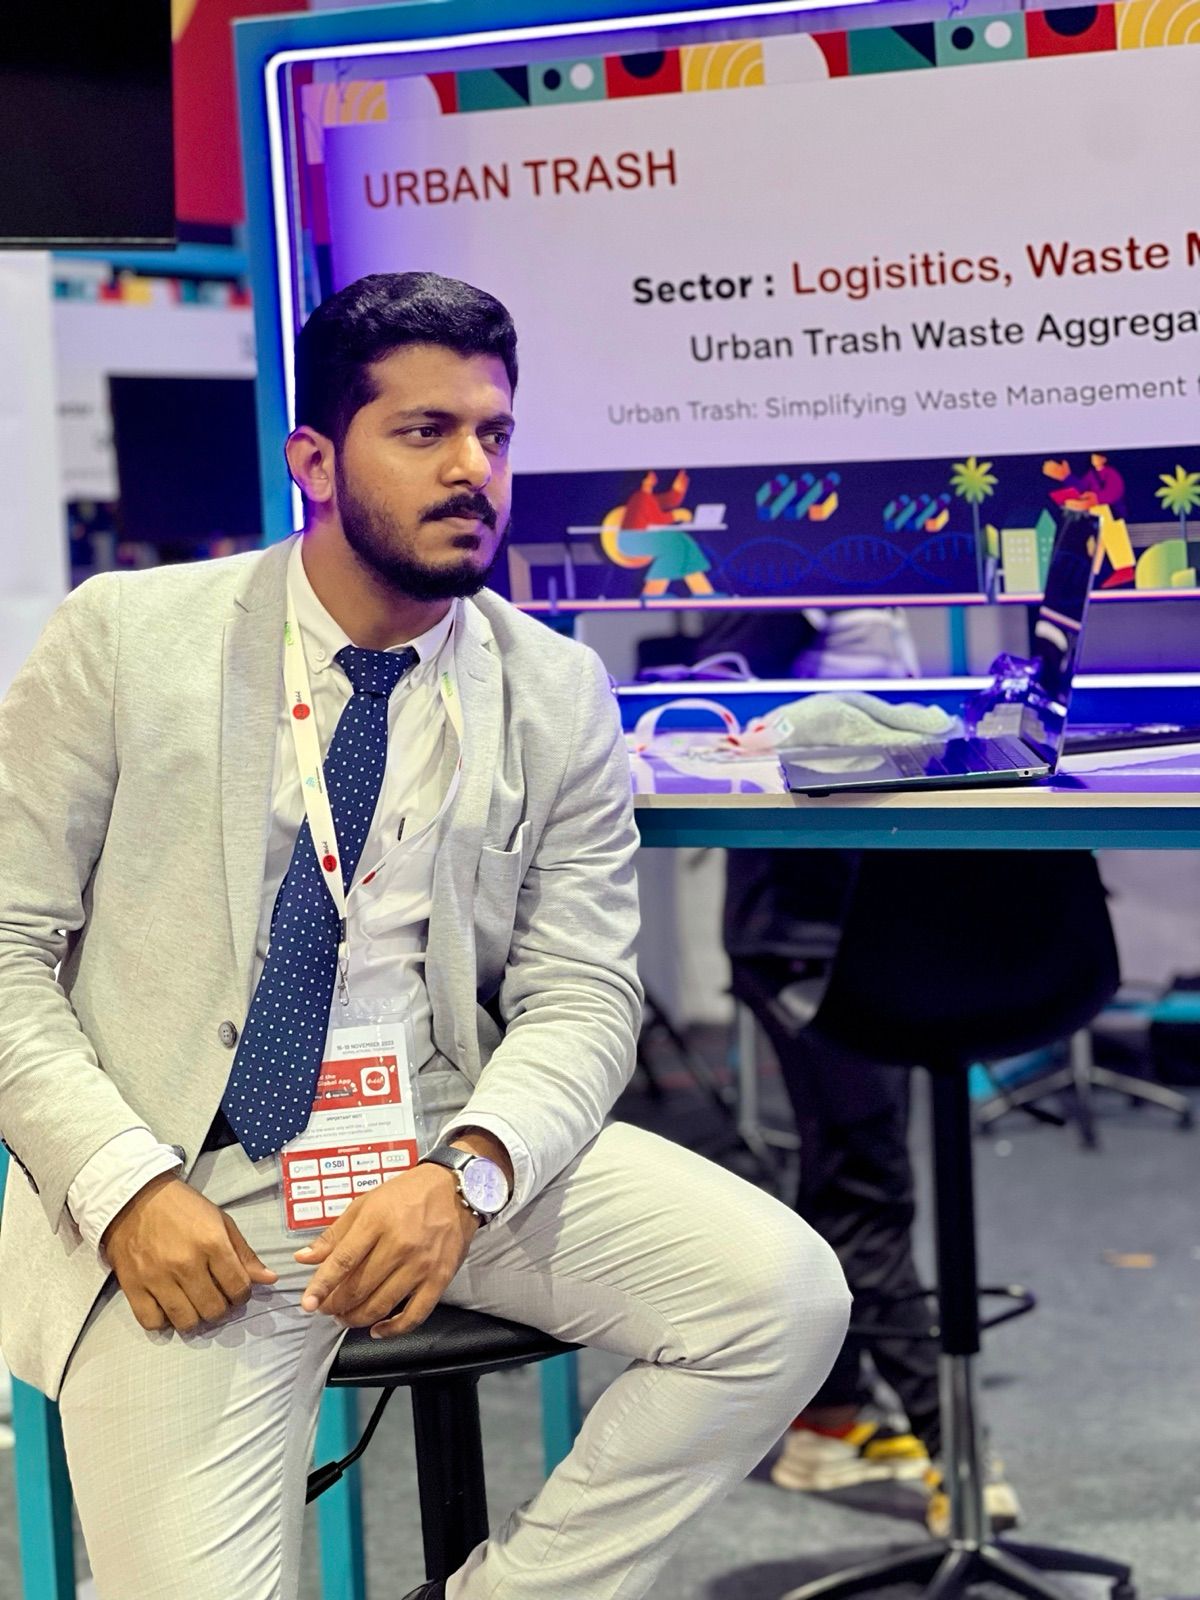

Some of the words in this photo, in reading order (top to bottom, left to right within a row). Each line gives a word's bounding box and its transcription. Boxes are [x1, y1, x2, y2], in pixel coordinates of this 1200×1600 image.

[364, 162, 510, 209] URBAN
[522, 147, 678, 198] TRASH
[632, 273, 754, 305] Sector
[791, 250, 1013, 301] Logisitics,
[1025, 236, 1171, 280] Waste
[691, 332, 794, 363] Urban
[802, 323, 902, 357] Trash
[911, 317, 1025, 351] Waste
[1036, 309, 1200, 349] Aggrega
[607, 403, 681, 426] Urban
[686, 399, 758, 422] Trash:
[765, 392, 908, 421] Simplifying
[914, 387, 998, 412] Waste
[1006, 375, 1188, 408] Management
[332, 1160, 345, 1168] SBI
